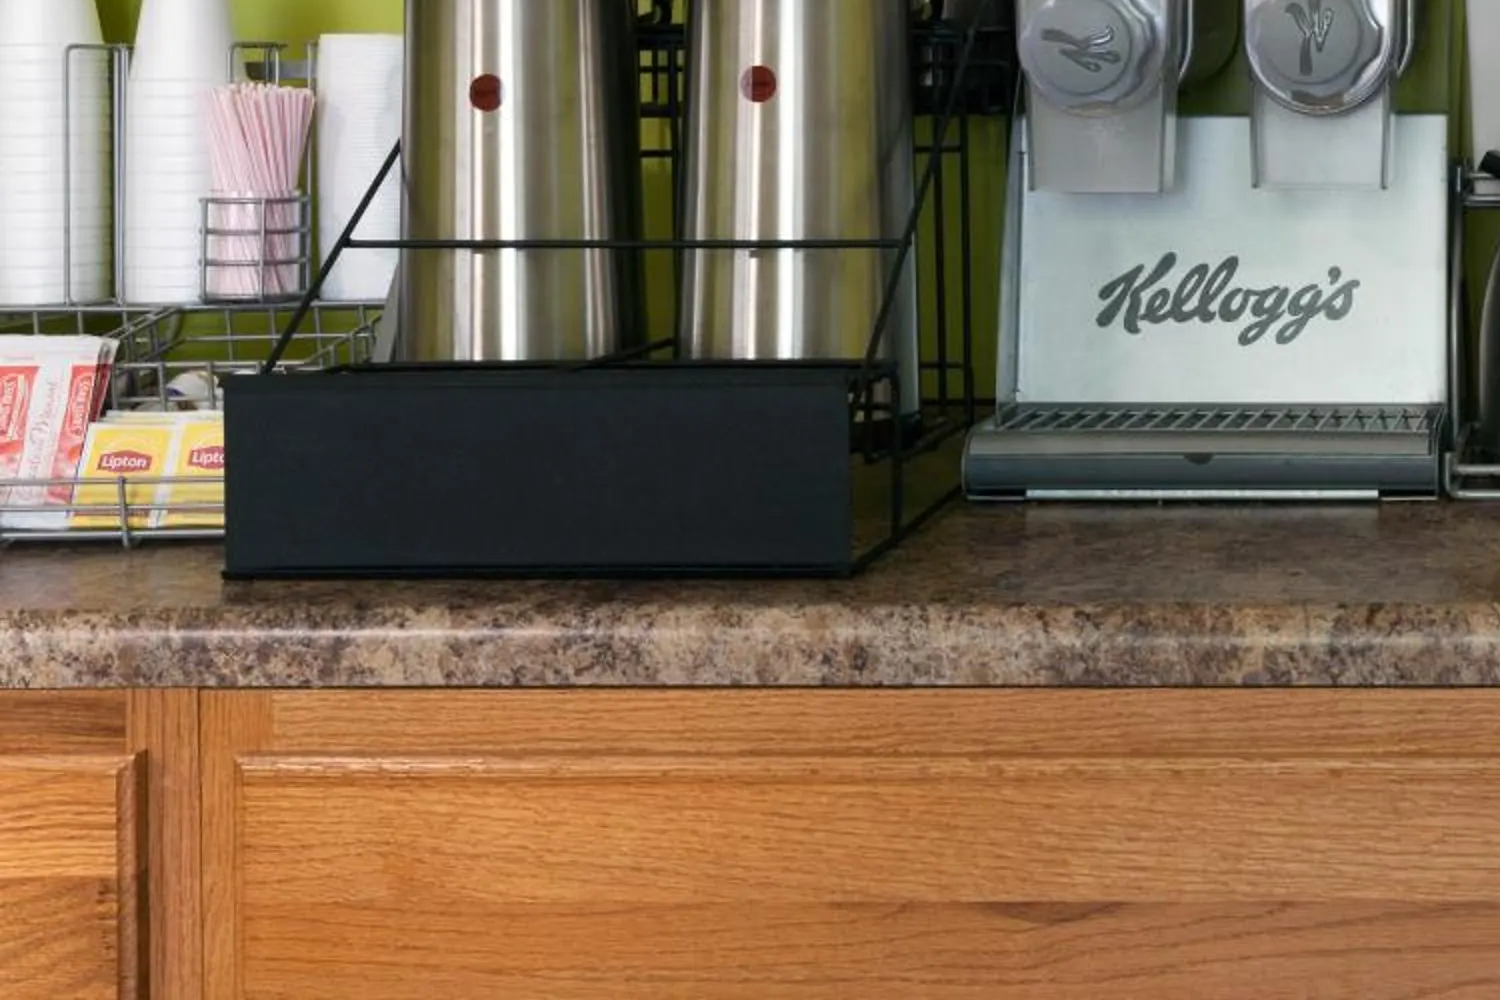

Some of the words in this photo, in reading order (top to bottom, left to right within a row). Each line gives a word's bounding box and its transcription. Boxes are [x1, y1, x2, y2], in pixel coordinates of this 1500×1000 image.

[1096, 251, 1360, 346] Kellogg's
[102, 455, 147, 468] Lipton
[191, 451, 224, 464] Lipto
